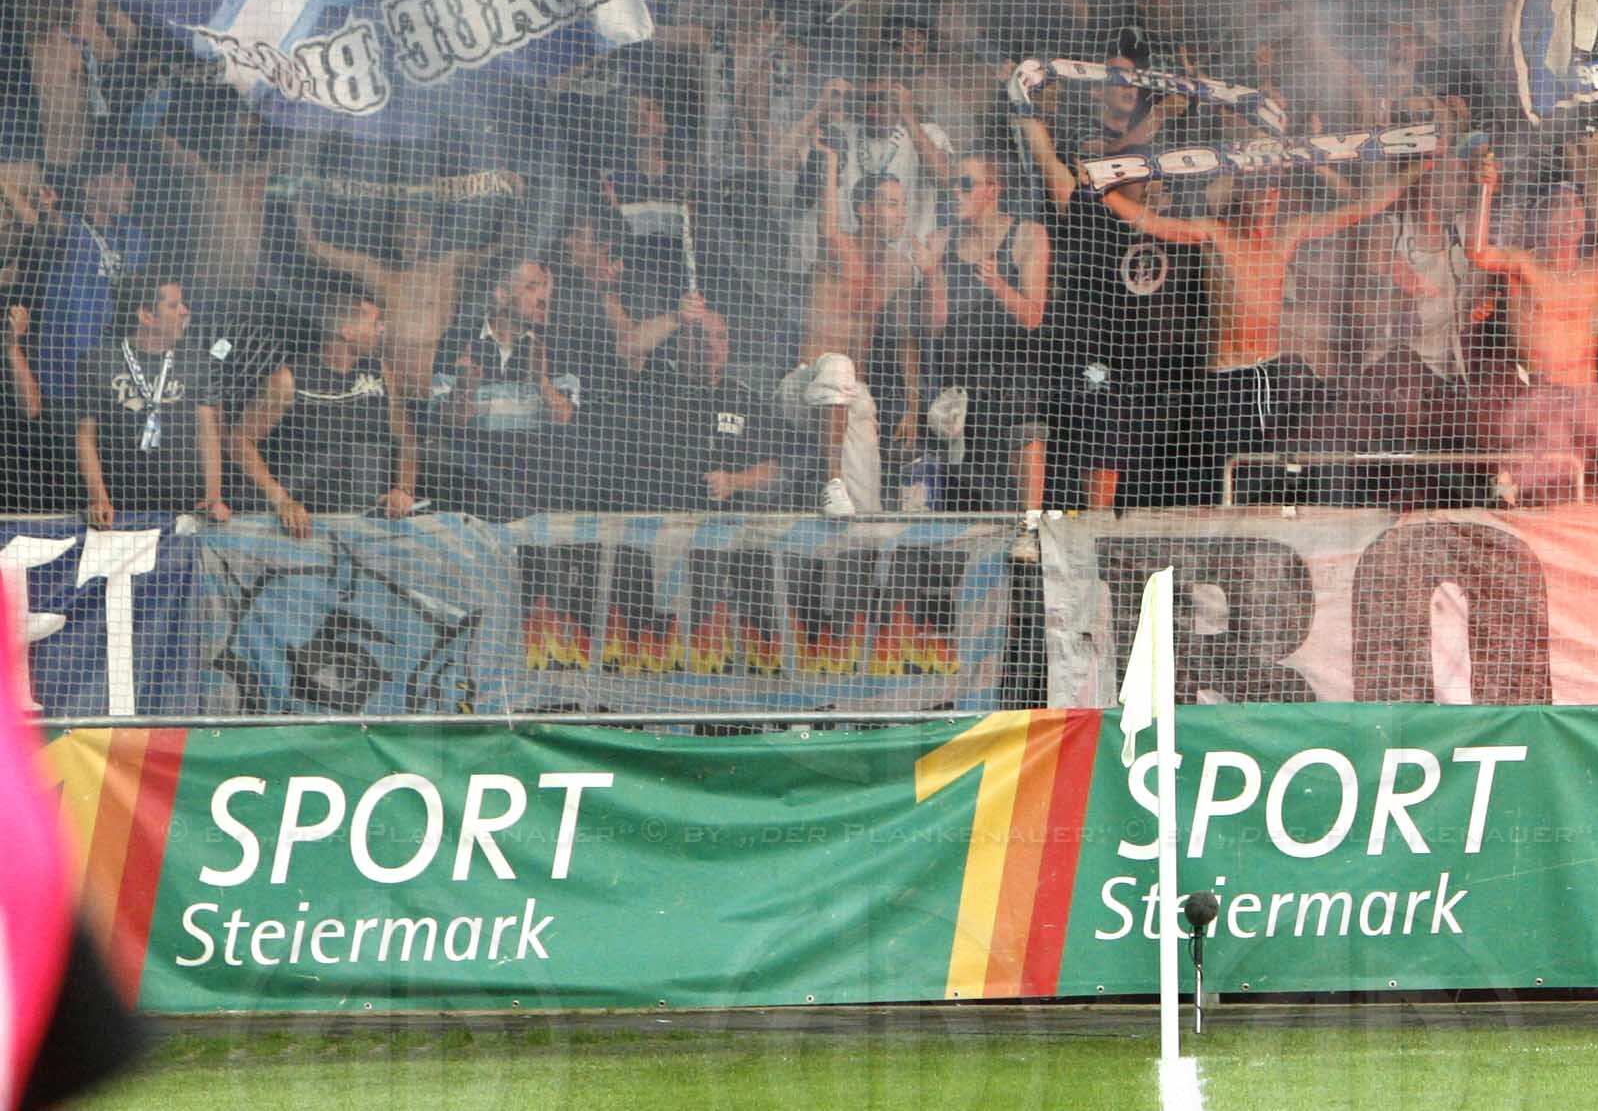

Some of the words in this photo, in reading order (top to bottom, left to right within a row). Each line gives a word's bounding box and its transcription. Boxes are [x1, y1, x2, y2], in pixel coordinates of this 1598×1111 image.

[200, 772, 614, 887] SPORT
[1117, 746, 1528, 861] SPORT
[175, 898, 555, 968] Steiermark
